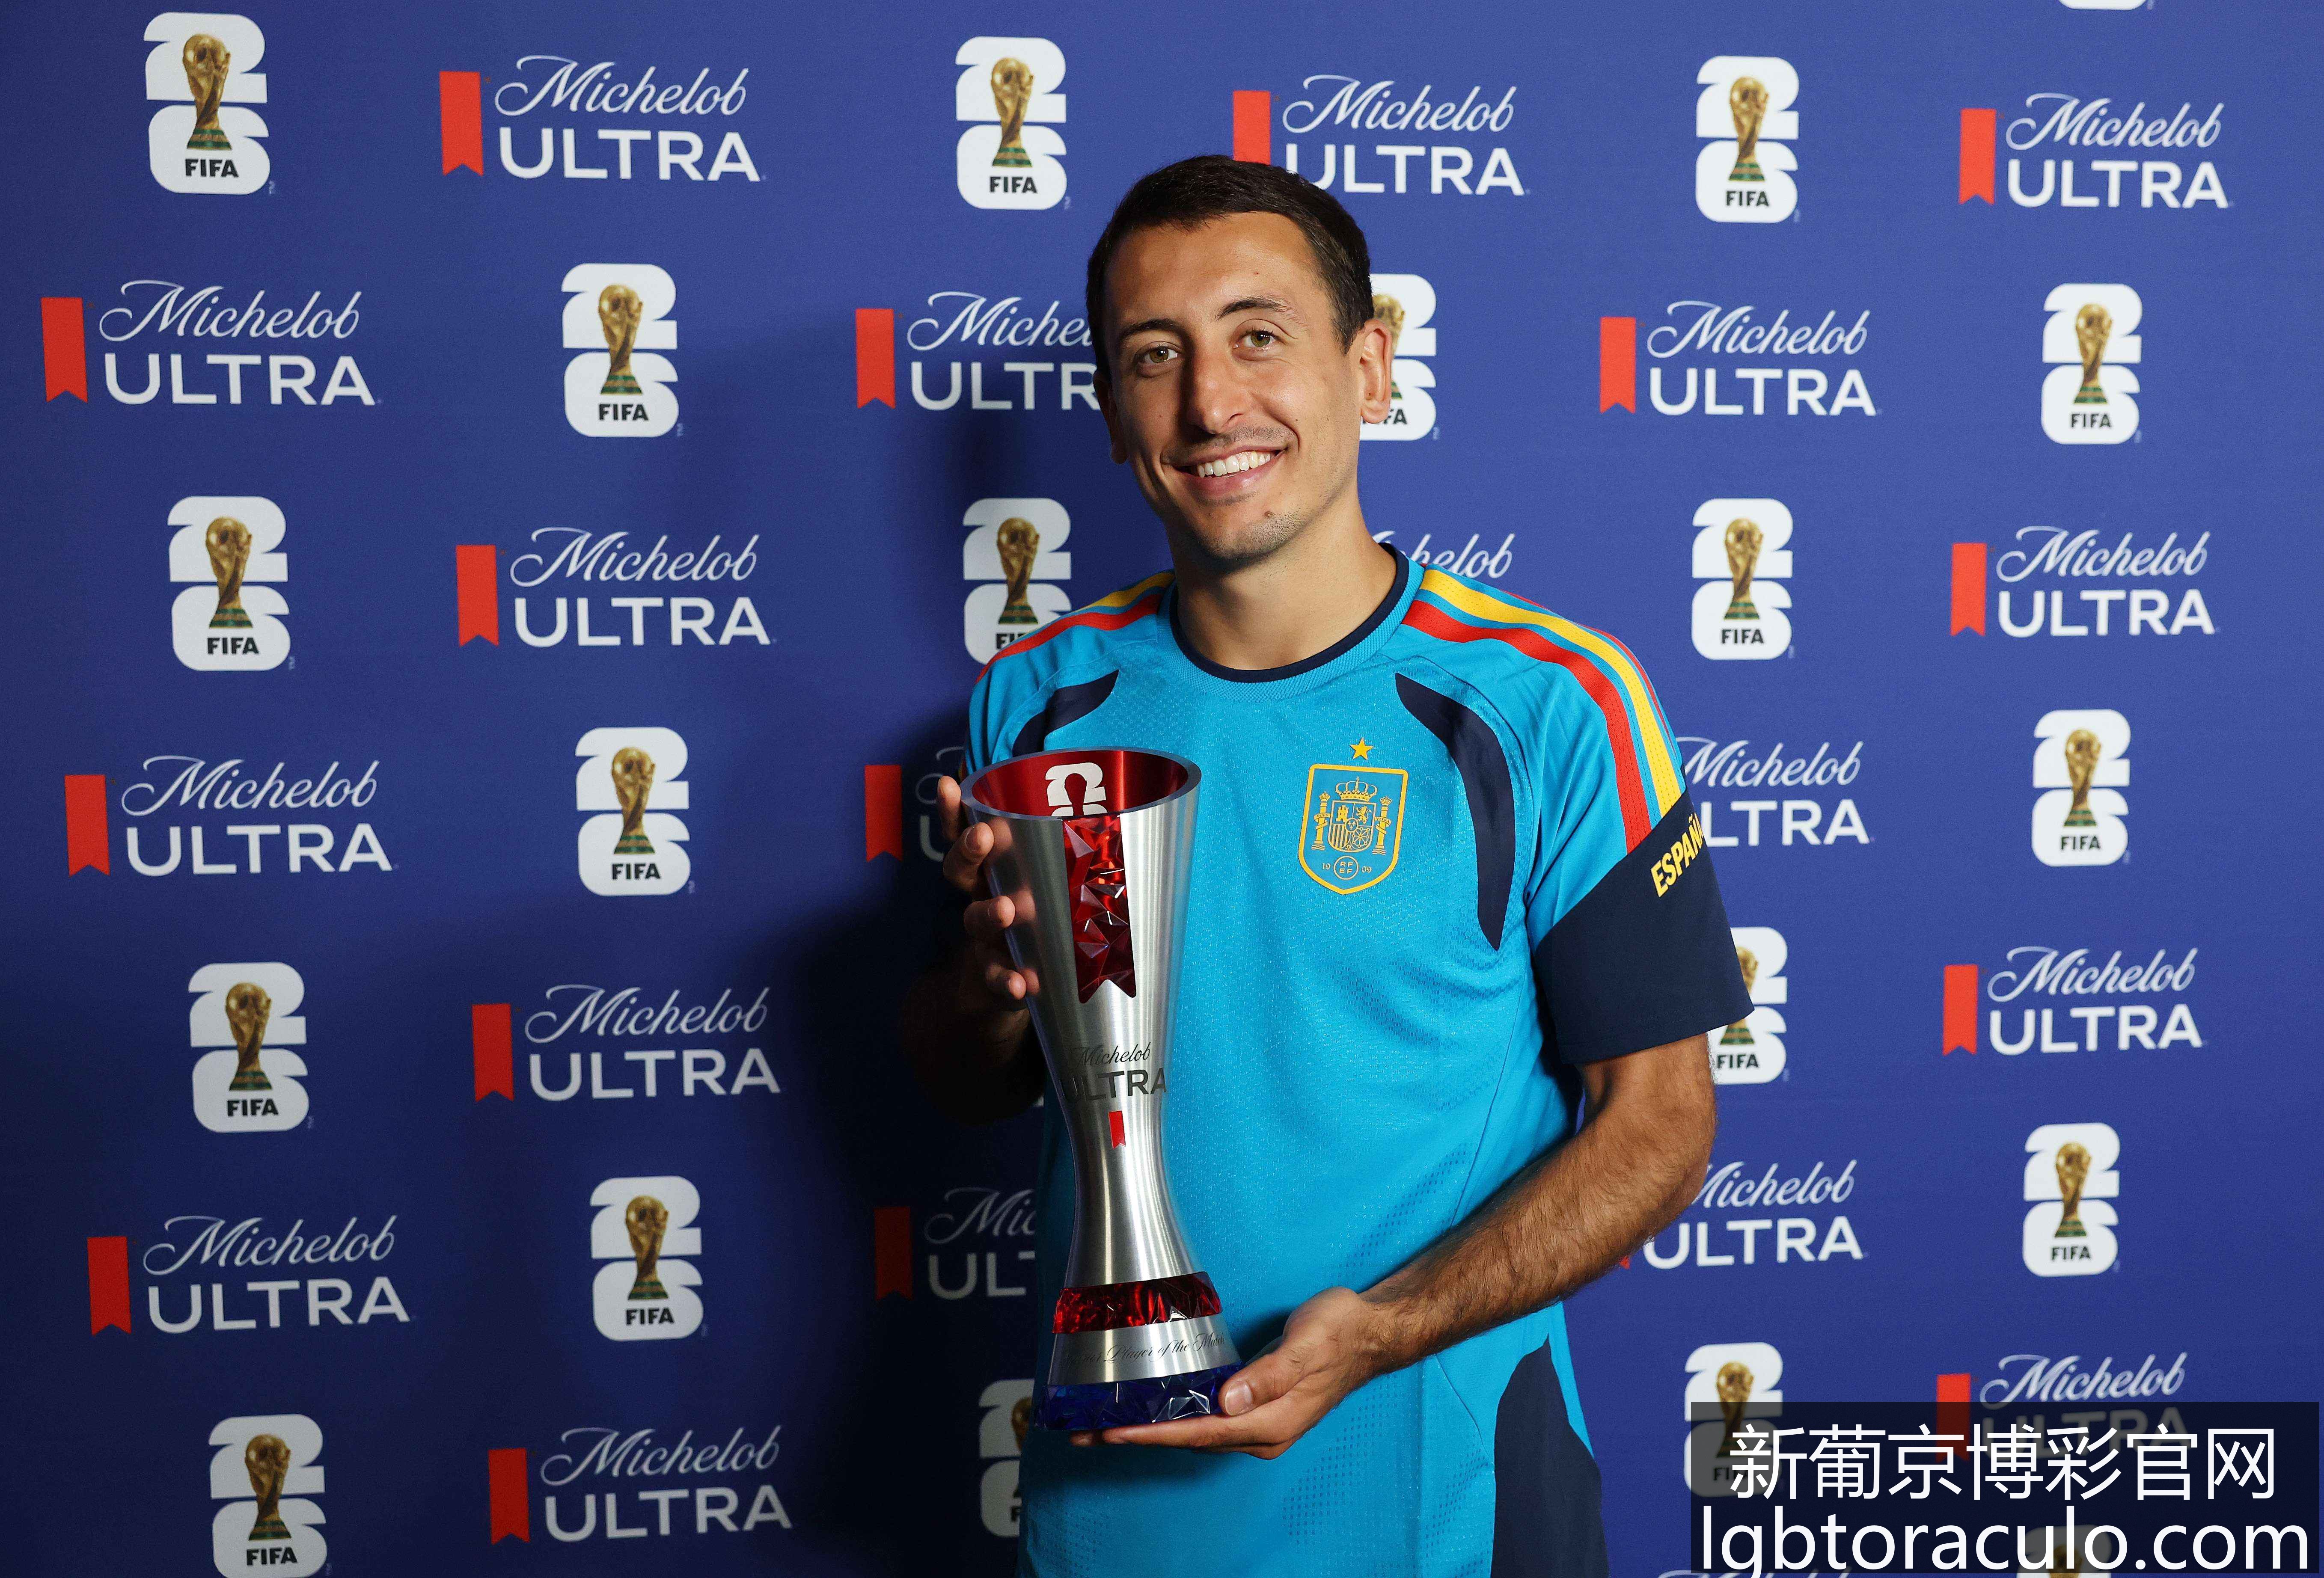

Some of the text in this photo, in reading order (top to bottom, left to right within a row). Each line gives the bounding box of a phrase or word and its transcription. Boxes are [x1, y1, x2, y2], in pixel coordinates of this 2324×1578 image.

[495, 55, 749, 116] Michelob
[1282, 75, 1516, 133] Michelob
[2006, 93, 2224, 150] Michelob
[185, 158, 239, 178] FIFA
[500, 128, 760, 181] ULTRA
[1286, 144, 1524, 196] ULTRA
[990, 176, 1037, 193] FIFA
[1726, 190, 1769, 207] FIFA
[2008, 159, 2228, 208] ULTRA
[99, 280, 362, 341] Michelob
[907, 291, 1092, 351] Miche
[1647, 300, 1869, 358] Michelob
[105, 353, 375, 405] ULTRA
[912, 362, 1101, 410] ULTR
[1650, 368, 1876, 415] ULTRA
[599, 403, 649, 421] FIFA
[2071, 413, 2111, 428] FIFA
[510, 527, 759, 587] Michelob
[1996, 526, 2210, 582] Michelob
[515, 597, 770, 647] ULTRA
[1721, 629, 1764, 644] FIFA
[1999, 589, 2214, 637] ULTRA
[207, 637, 259, 655] FIFA
[122, 755, 380, 816] Michelob
[1699, 798, 1870, 847] LTRA
[2061, 836, 2101, 850] FIFA
[127, 824, 392, 876] ULTRA
[612, 863, 660, 880] FIFA
[1650, 812, 1704, 898] ESPAÑ
[1988, 946, 2198, 1002] Michelob
[525, 985, 768, 1043] Michelob
[1990, 1004, 2202, 1055] ULTRA
[530, 1049, 779, 1100] ULTRA
[1717, 1054, 1759, 1069] FIFA
[227, 1098, 279, 1117] FIFA
[143, 1215, 396, 1275] Michelob
[1643, 1216, 1863, 1270] ULTRA
[2051, 1246, 2091, 1261] FIFA
[149, 1277, 410, 1333] ULTRA
[626, 1307, 674, 1326] FIFA
[1103, 1345, 1153, 1363] Player
[1172, 1340, 1191, 1353] the
[1979, 1351, 2188, 1410] Michelob
[541, 1426, 781, 1486] Michelob
[546, 1485, 791, 1542] ULTRA
[247, 1547, 297, 1566] FIFA
